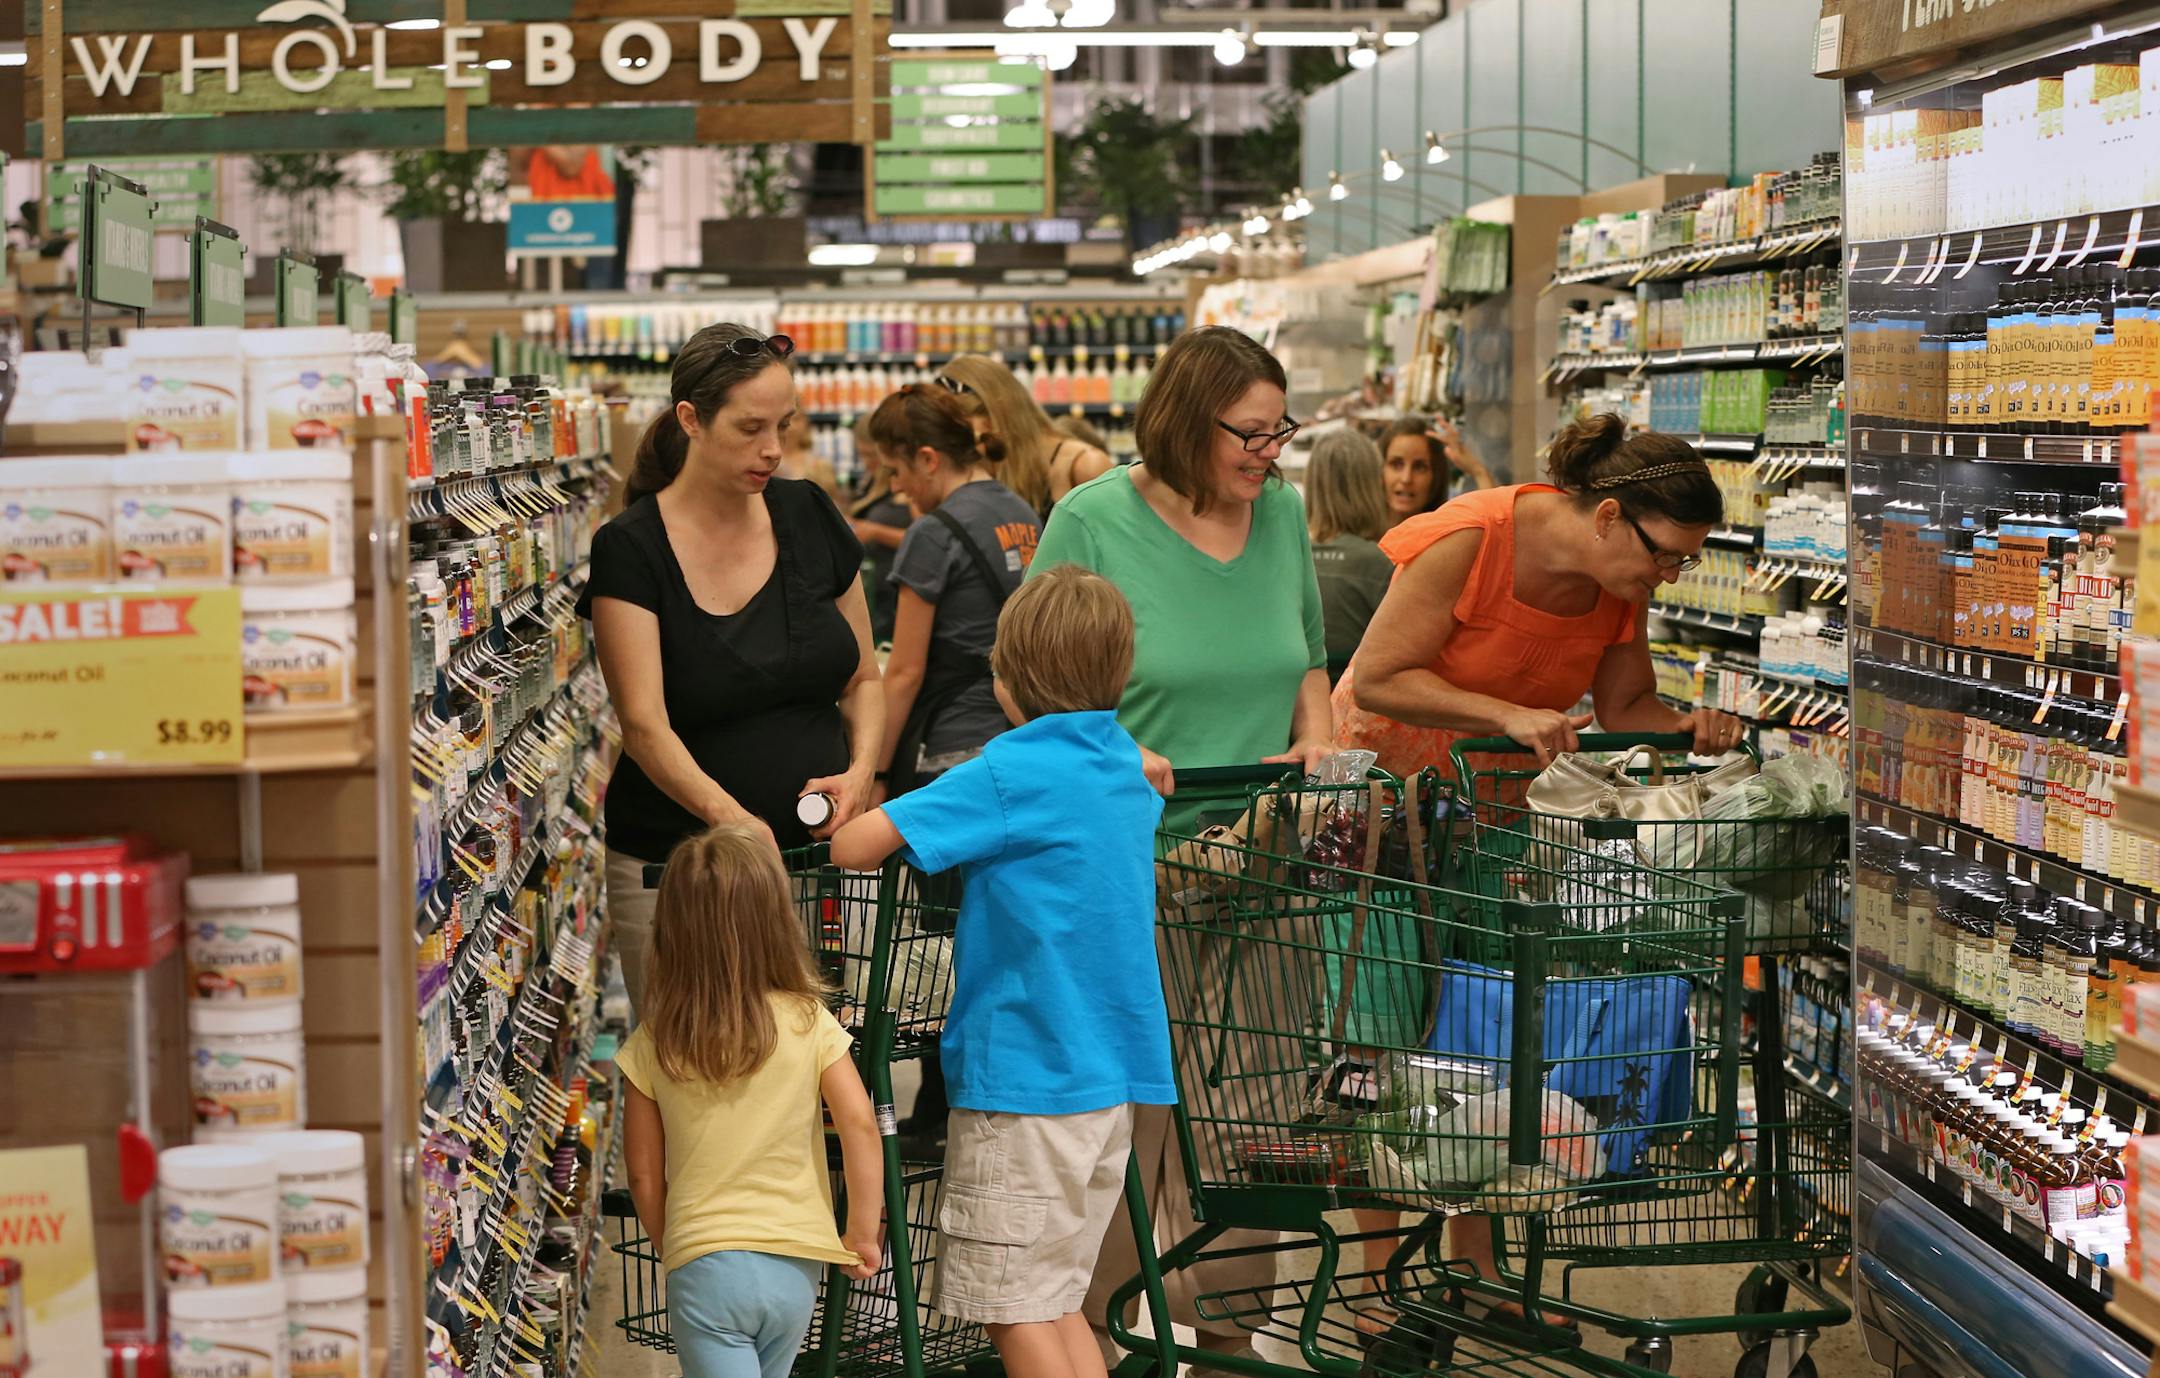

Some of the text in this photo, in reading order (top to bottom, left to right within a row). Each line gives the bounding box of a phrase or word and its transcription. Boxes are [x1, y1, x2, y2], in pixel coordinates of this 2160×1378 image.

[71, 27, 485, 97] WHOLE
[526, 17, 838, 87] BODY
[0, 596, 124, 643] SALE!
[157, 718, 232, 744] $8.99
[231, 1232, 251, 1251] Oil
